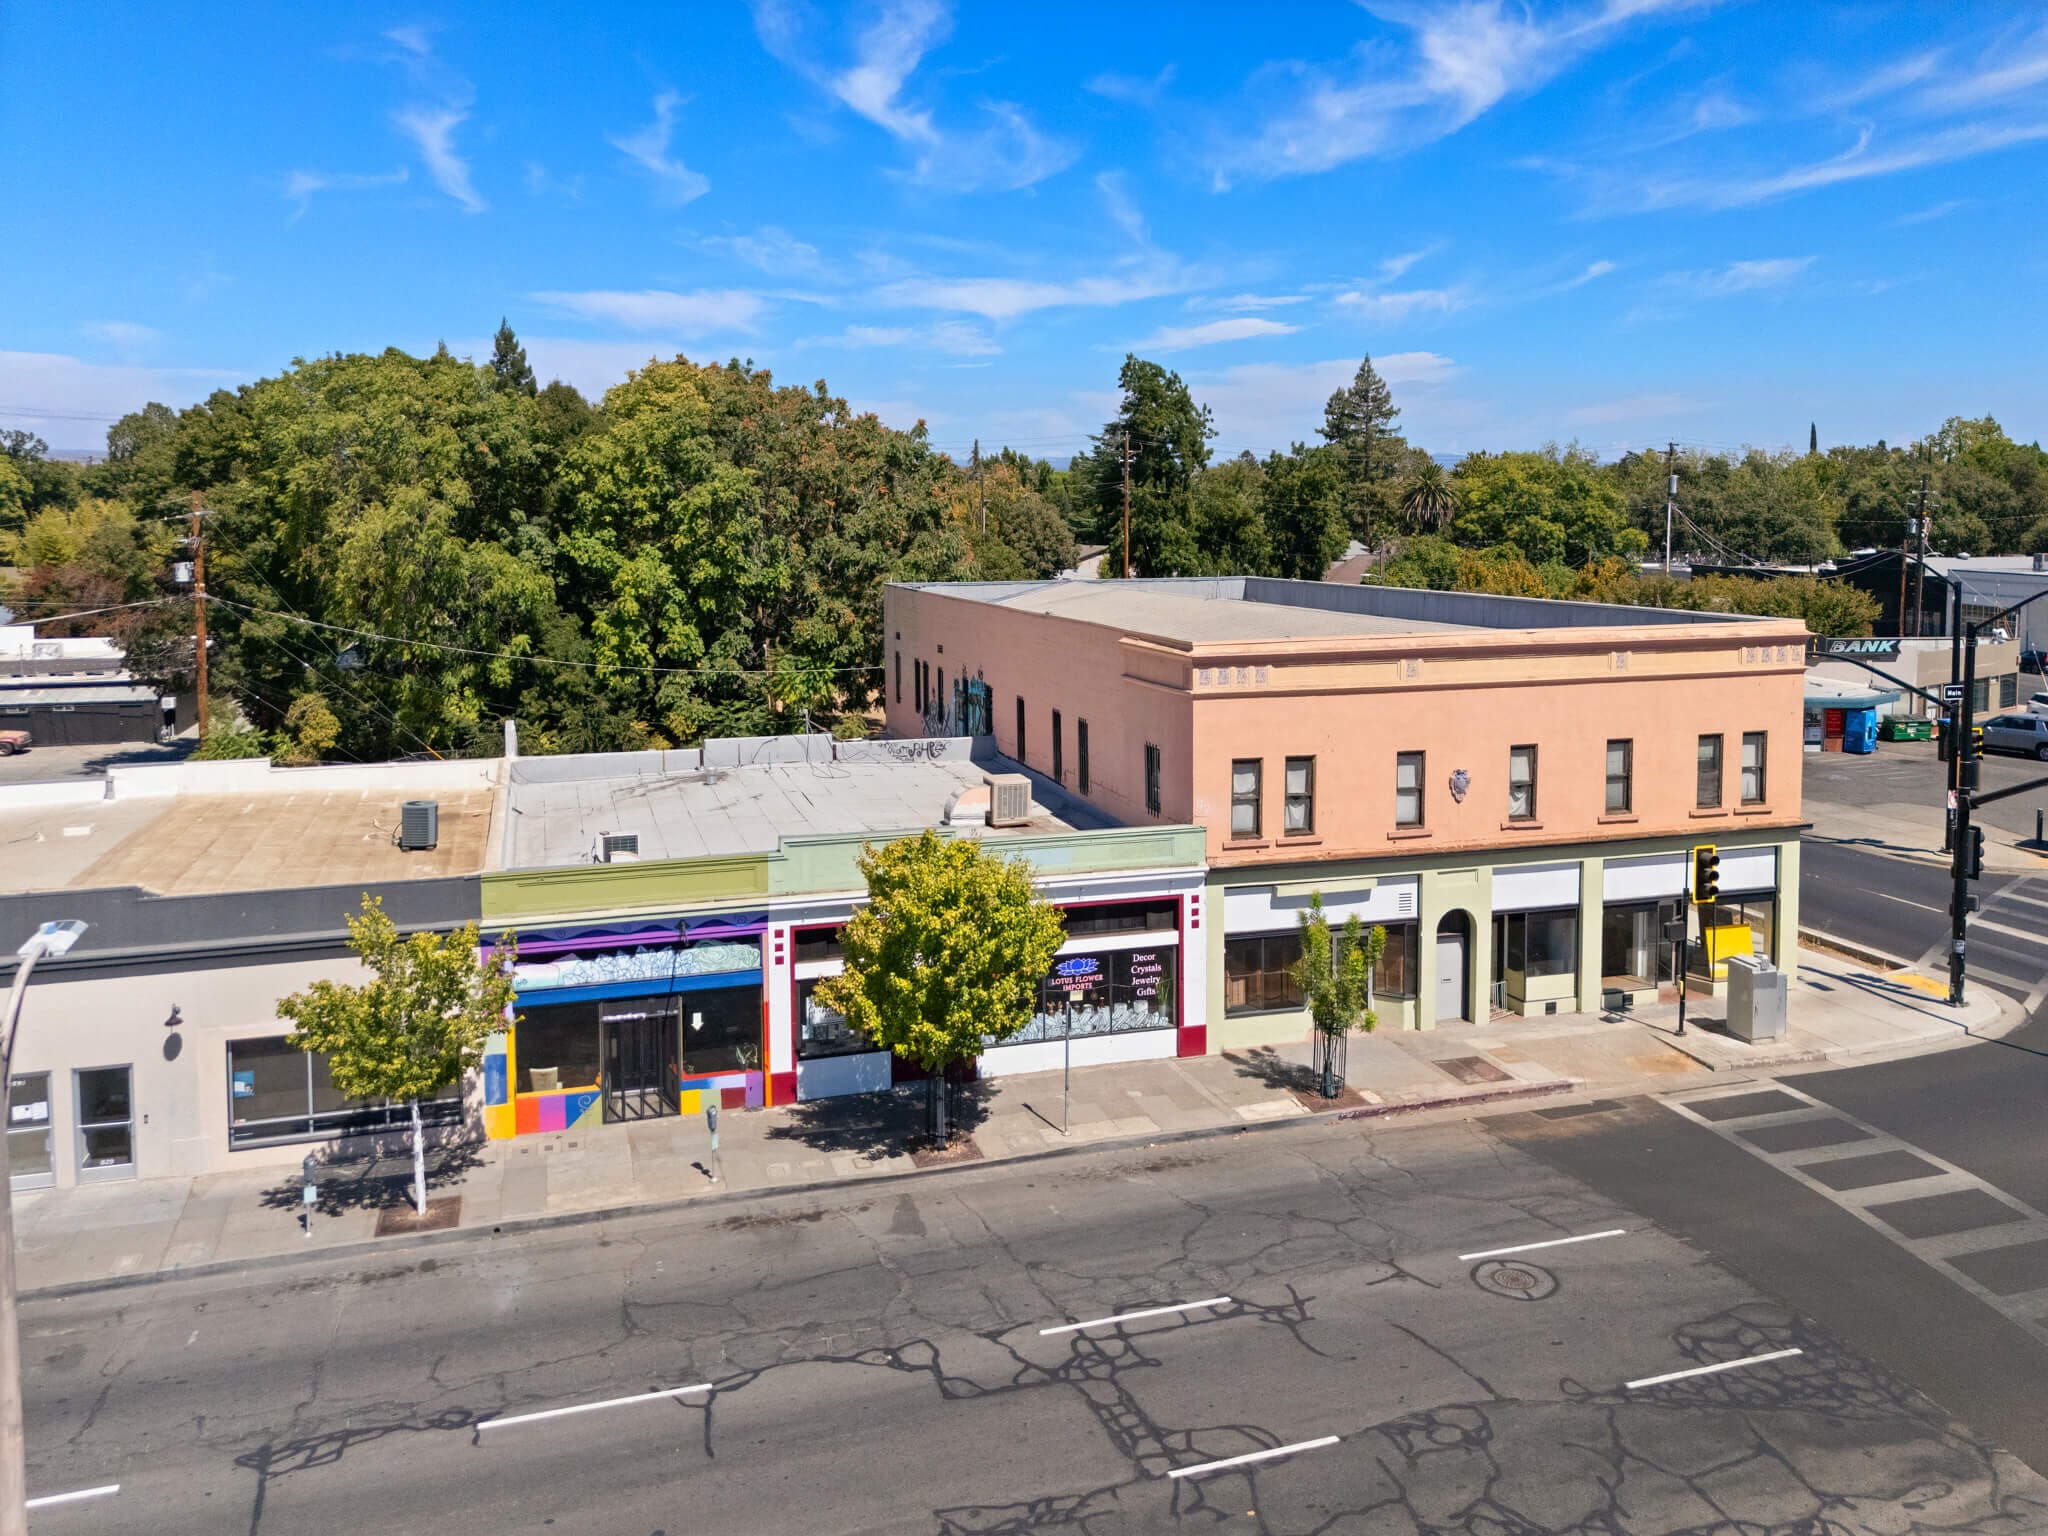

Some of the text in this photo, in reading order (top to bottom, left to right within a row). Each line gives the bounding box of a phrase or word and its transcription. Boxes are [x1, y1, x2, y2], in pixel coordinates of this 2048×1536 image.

[1829, 640, 1897, 653] BANK
[1132, 953, 1156, 962] Decor
[1131, 963, 1162, 975] Crystals
[1051, 974, 1103, 985] LOTUS FLOWER
[1131, 975, 1160, 985] Jewelry
[1062, 983, 1092, 991] IMPORTS
[1136, 986, 1156, 996] Gifts
